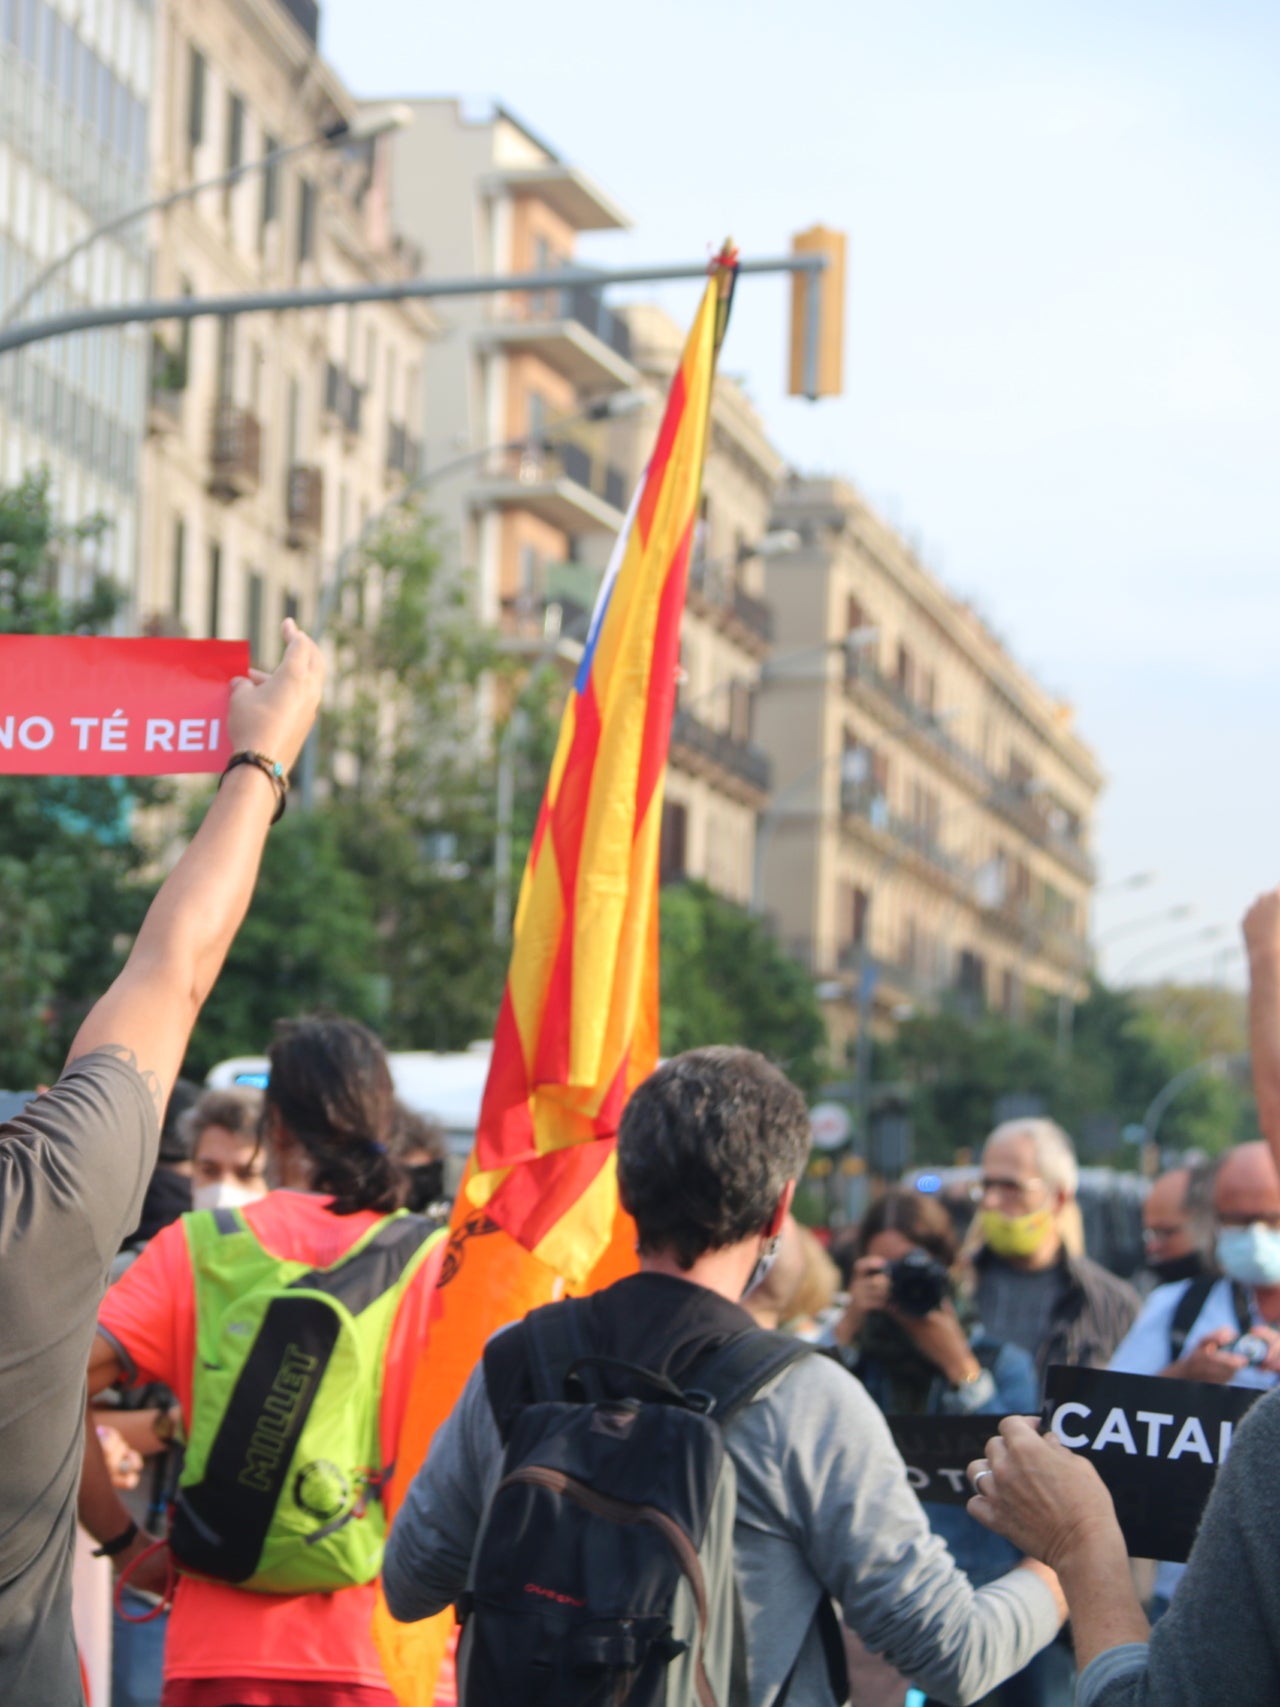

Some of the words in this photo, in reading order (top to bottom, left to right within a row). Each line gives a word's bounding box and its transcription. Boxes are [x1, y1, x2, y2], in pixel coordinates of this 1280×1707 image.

[70, 708, 129, 751] TÉ
[145, 718, 220, 751] REI
[236, 1343, 319, 1493] MILLET
